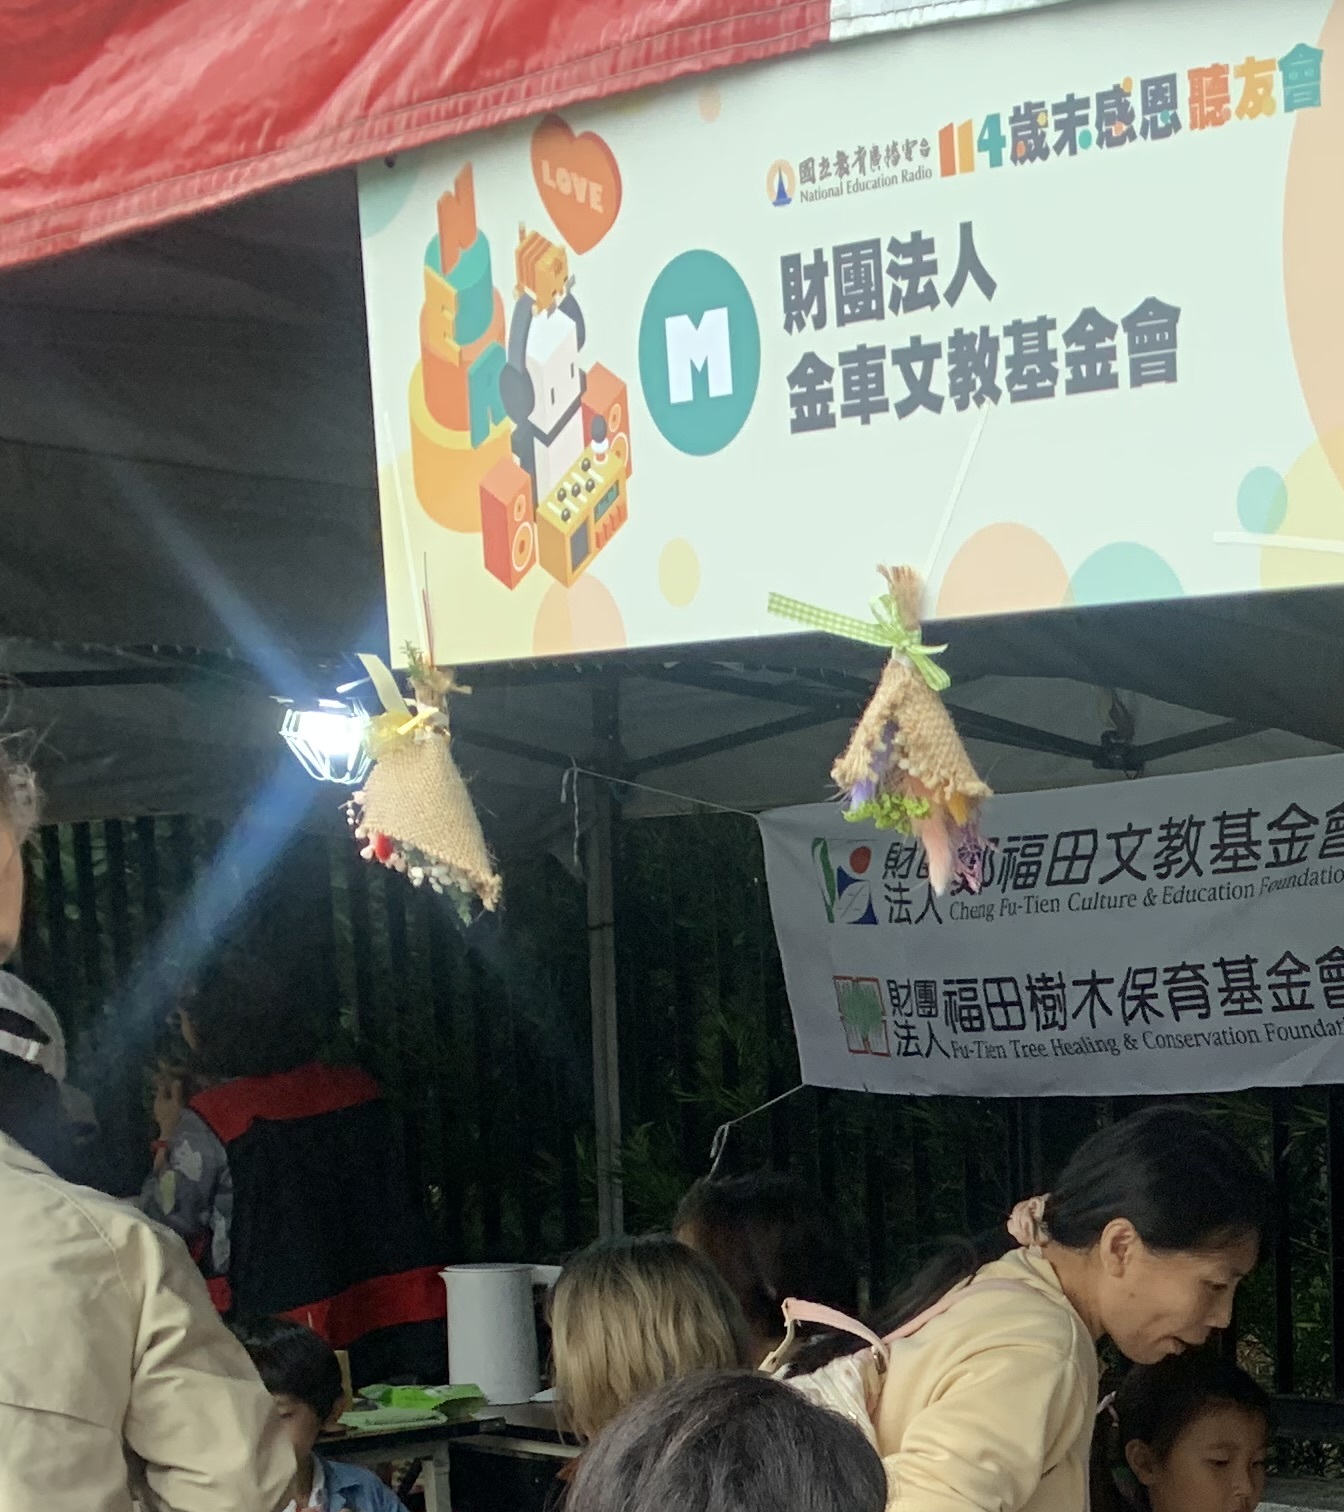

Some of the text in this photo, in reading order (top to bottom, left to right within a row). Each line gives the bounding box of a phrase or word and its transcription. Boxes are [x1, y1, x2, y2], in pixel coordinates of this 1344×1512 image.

[938, 42, 1323, 178] 114歲末感恩聽友會
[541, 160, 604, 214] LOVE
[800, 164, 932, 203] National Education Radio
[779, 220, 998, 337] 財團法人
[664, 306, 734, 405] M
[785, 295, 1182, 436] 金車文教基金會
[884, 882, 942, 924] 法人
[950, 901, 995, 922] Cheng
[999, 895, 1060, 916] Fu-Tien
[1068, 892, 1137, 912] Culture
[1143, 887, 1157, 906] &
[1162, 882, 1255, 905] Education
[886, 978, 939, 1018] 財團
[894, 1020, 950, 1060] 法人
[951, 1039, 1004, 1060] Fu-Tien
[1009, 1038, 1049, 1058] Tree
[1050, 1035, 1120, 1056] Healing
[1123, 1032, 1138, 1051] &
[1142, 1025, 1262, 1050] Conservation
